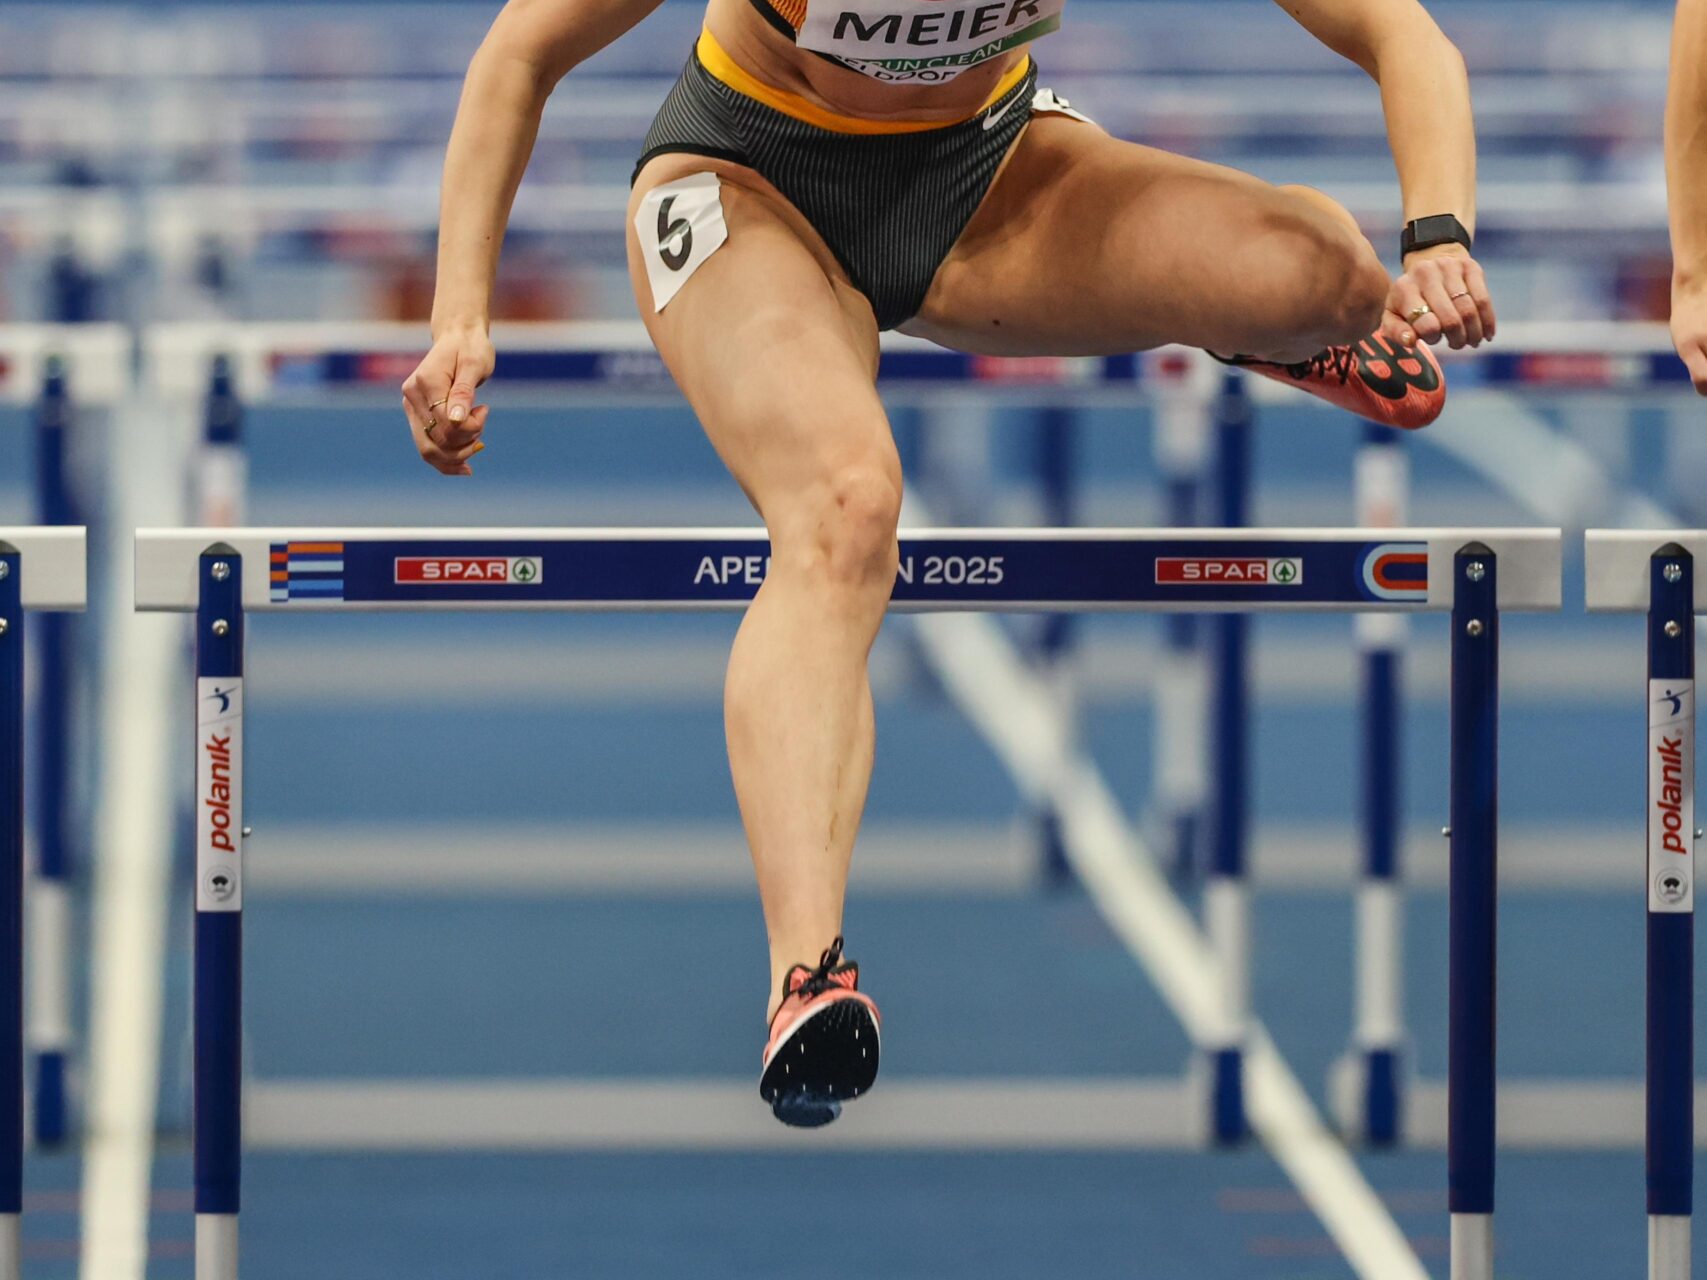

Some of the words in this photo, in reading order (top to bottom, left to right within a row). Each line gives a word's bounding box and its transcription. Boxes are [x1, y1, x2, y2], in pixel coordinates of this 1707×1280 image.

[926, 39, 1003, 68] CLEAN
[656, 193, 693, 272] 6
[422, 562, 506, 579] SPAR
[923, 556, 1004, 585] 2025
[1182, 561, 1266, 580] SPAR
[206, 733, 236, 852] polanik
[1657, 735, 1687, 854] polanik
